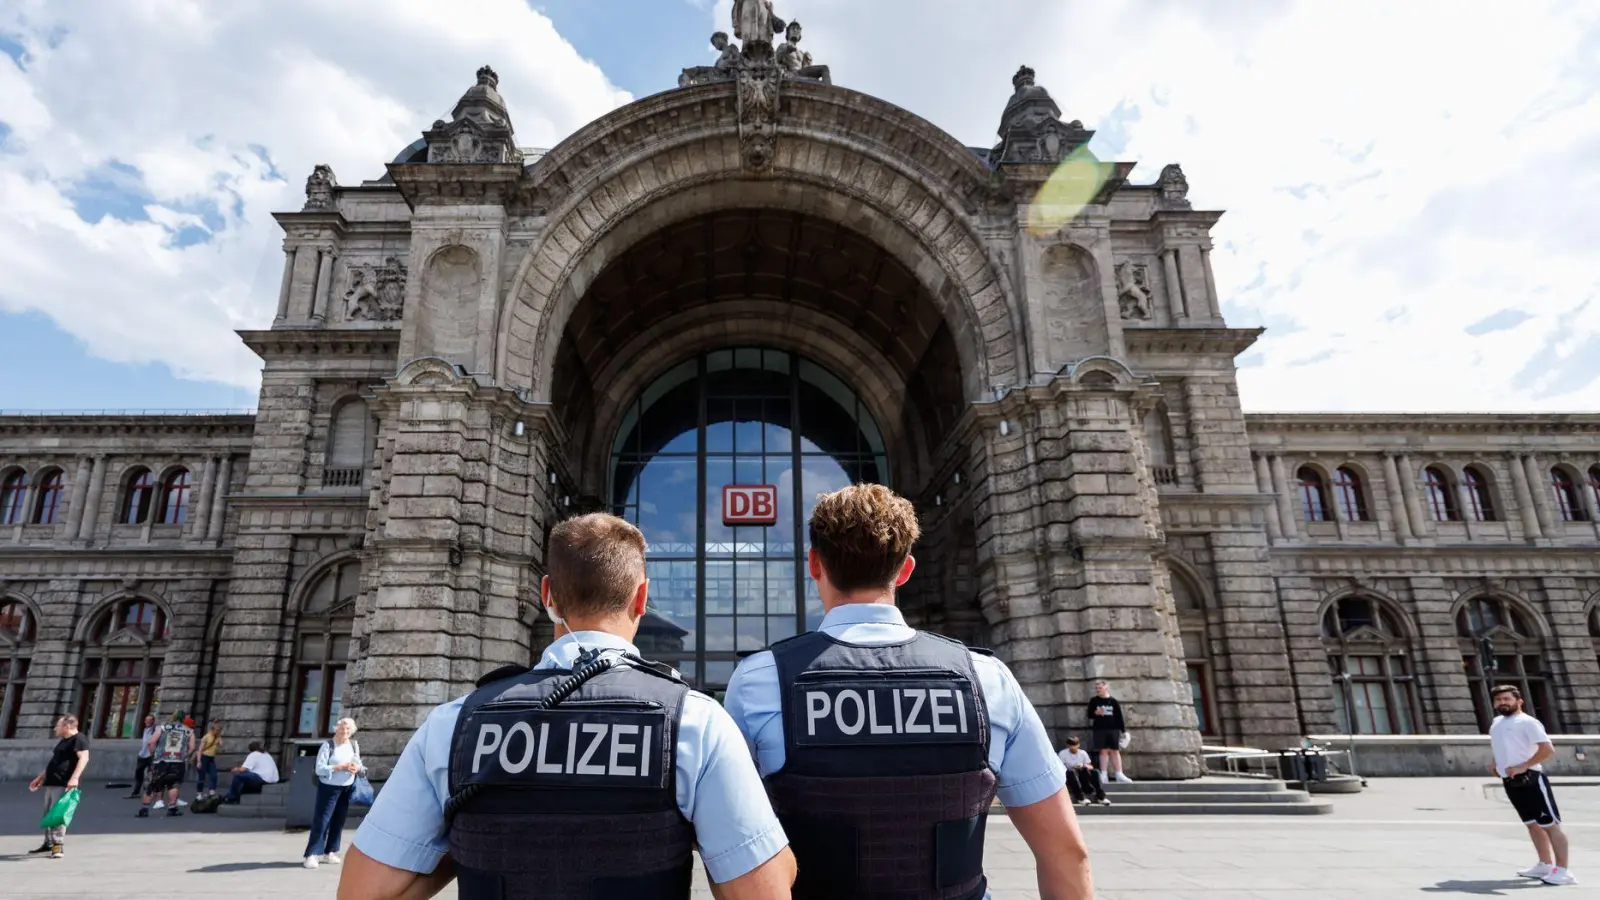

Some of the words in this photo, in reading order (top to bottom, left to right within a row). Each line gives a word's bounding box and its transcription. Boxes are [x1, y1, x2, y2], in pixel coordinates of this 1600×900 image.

[730, 491, 772, 516] DB
[806, 689, 968, 736] POLIZEI
[471, 721, 652, 777] POLIZEI
